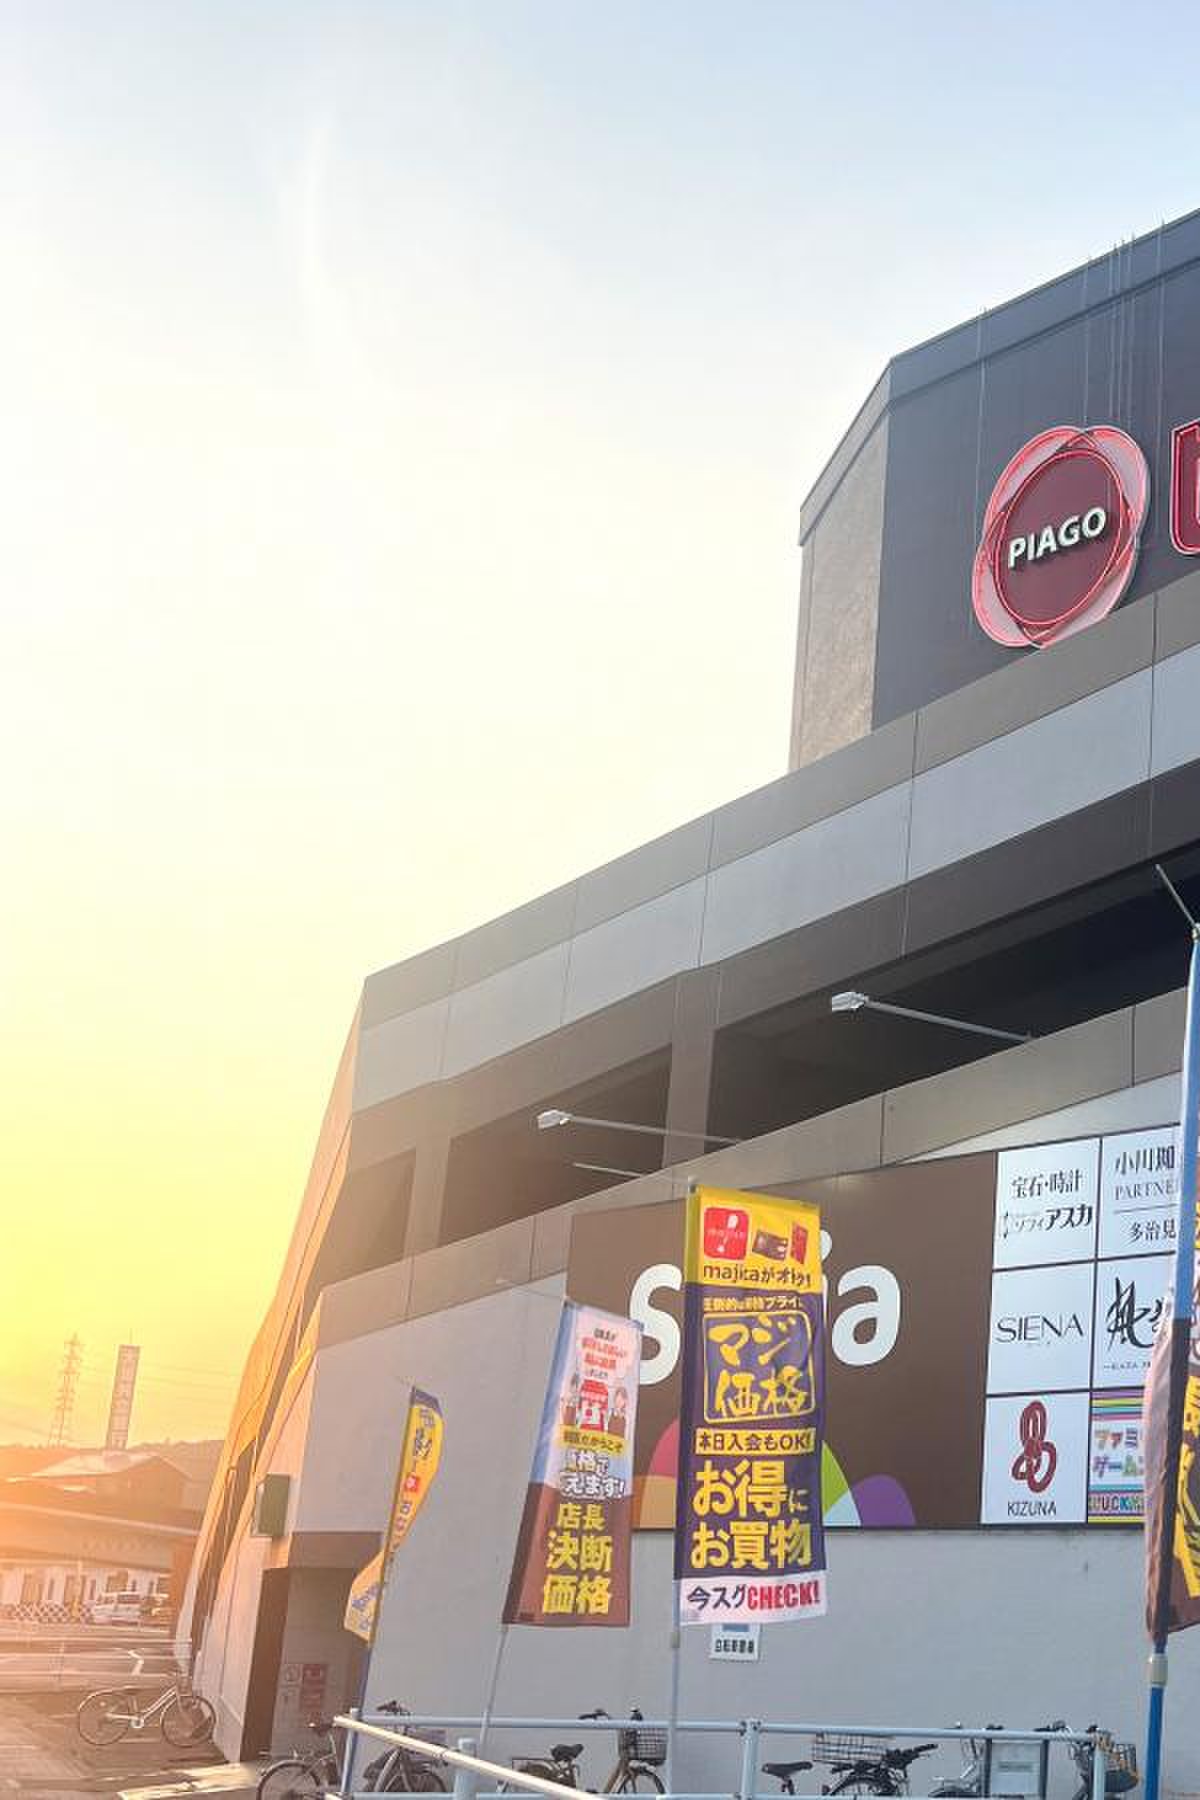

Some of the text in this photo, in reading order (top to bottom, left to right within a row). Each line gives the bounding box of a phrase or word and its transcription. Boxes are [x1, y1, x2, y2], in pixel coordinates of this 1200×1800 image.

[1007, 506, 1107, 568] PIAGO
[996, 1313, 1084, 1343] SIENA
[714, 1365, 807, 1417] 価格
[692, 1458, 810, 1519] お得に
[1007, 1500, 1058, 1516] KIZUNA
[556, 1502, 606, 1533] 店長
[546, 1532, 613, 1573] 決断
[690, 1519, 812, 1571] お買物
[542, 1574, 612, 1616] 価格
[686, 1580, 820, 1611] 今スグCHECK!
